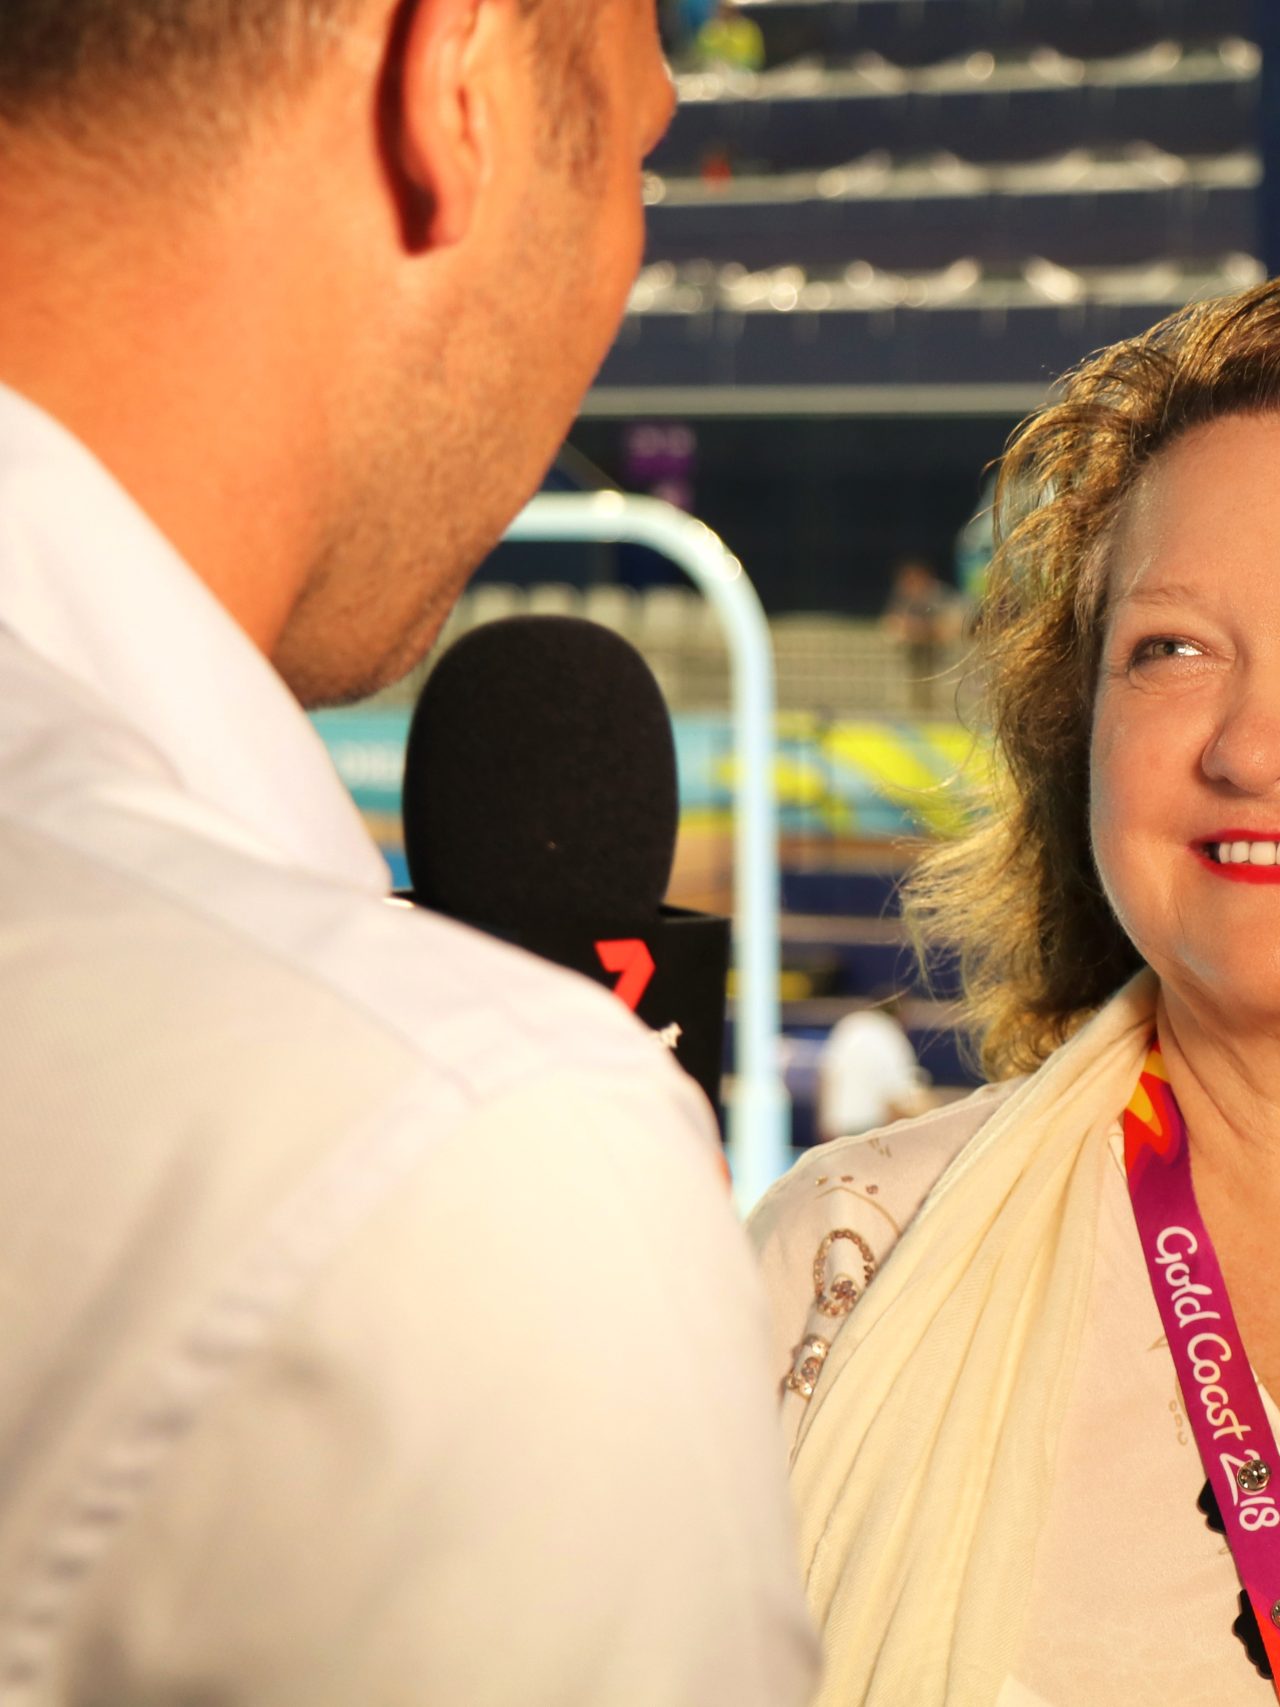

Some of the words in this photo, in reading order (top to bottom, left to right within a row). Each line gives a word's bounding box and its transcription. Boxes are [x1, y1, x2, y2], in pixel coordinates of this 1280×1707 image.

[594, 938, 656, 1013] 7
[1155, 1225, 1220, 1328] Gold
[1187, 1333, 1251, 1440] Coast
[1219, 1448, 1280, 1532] 218
